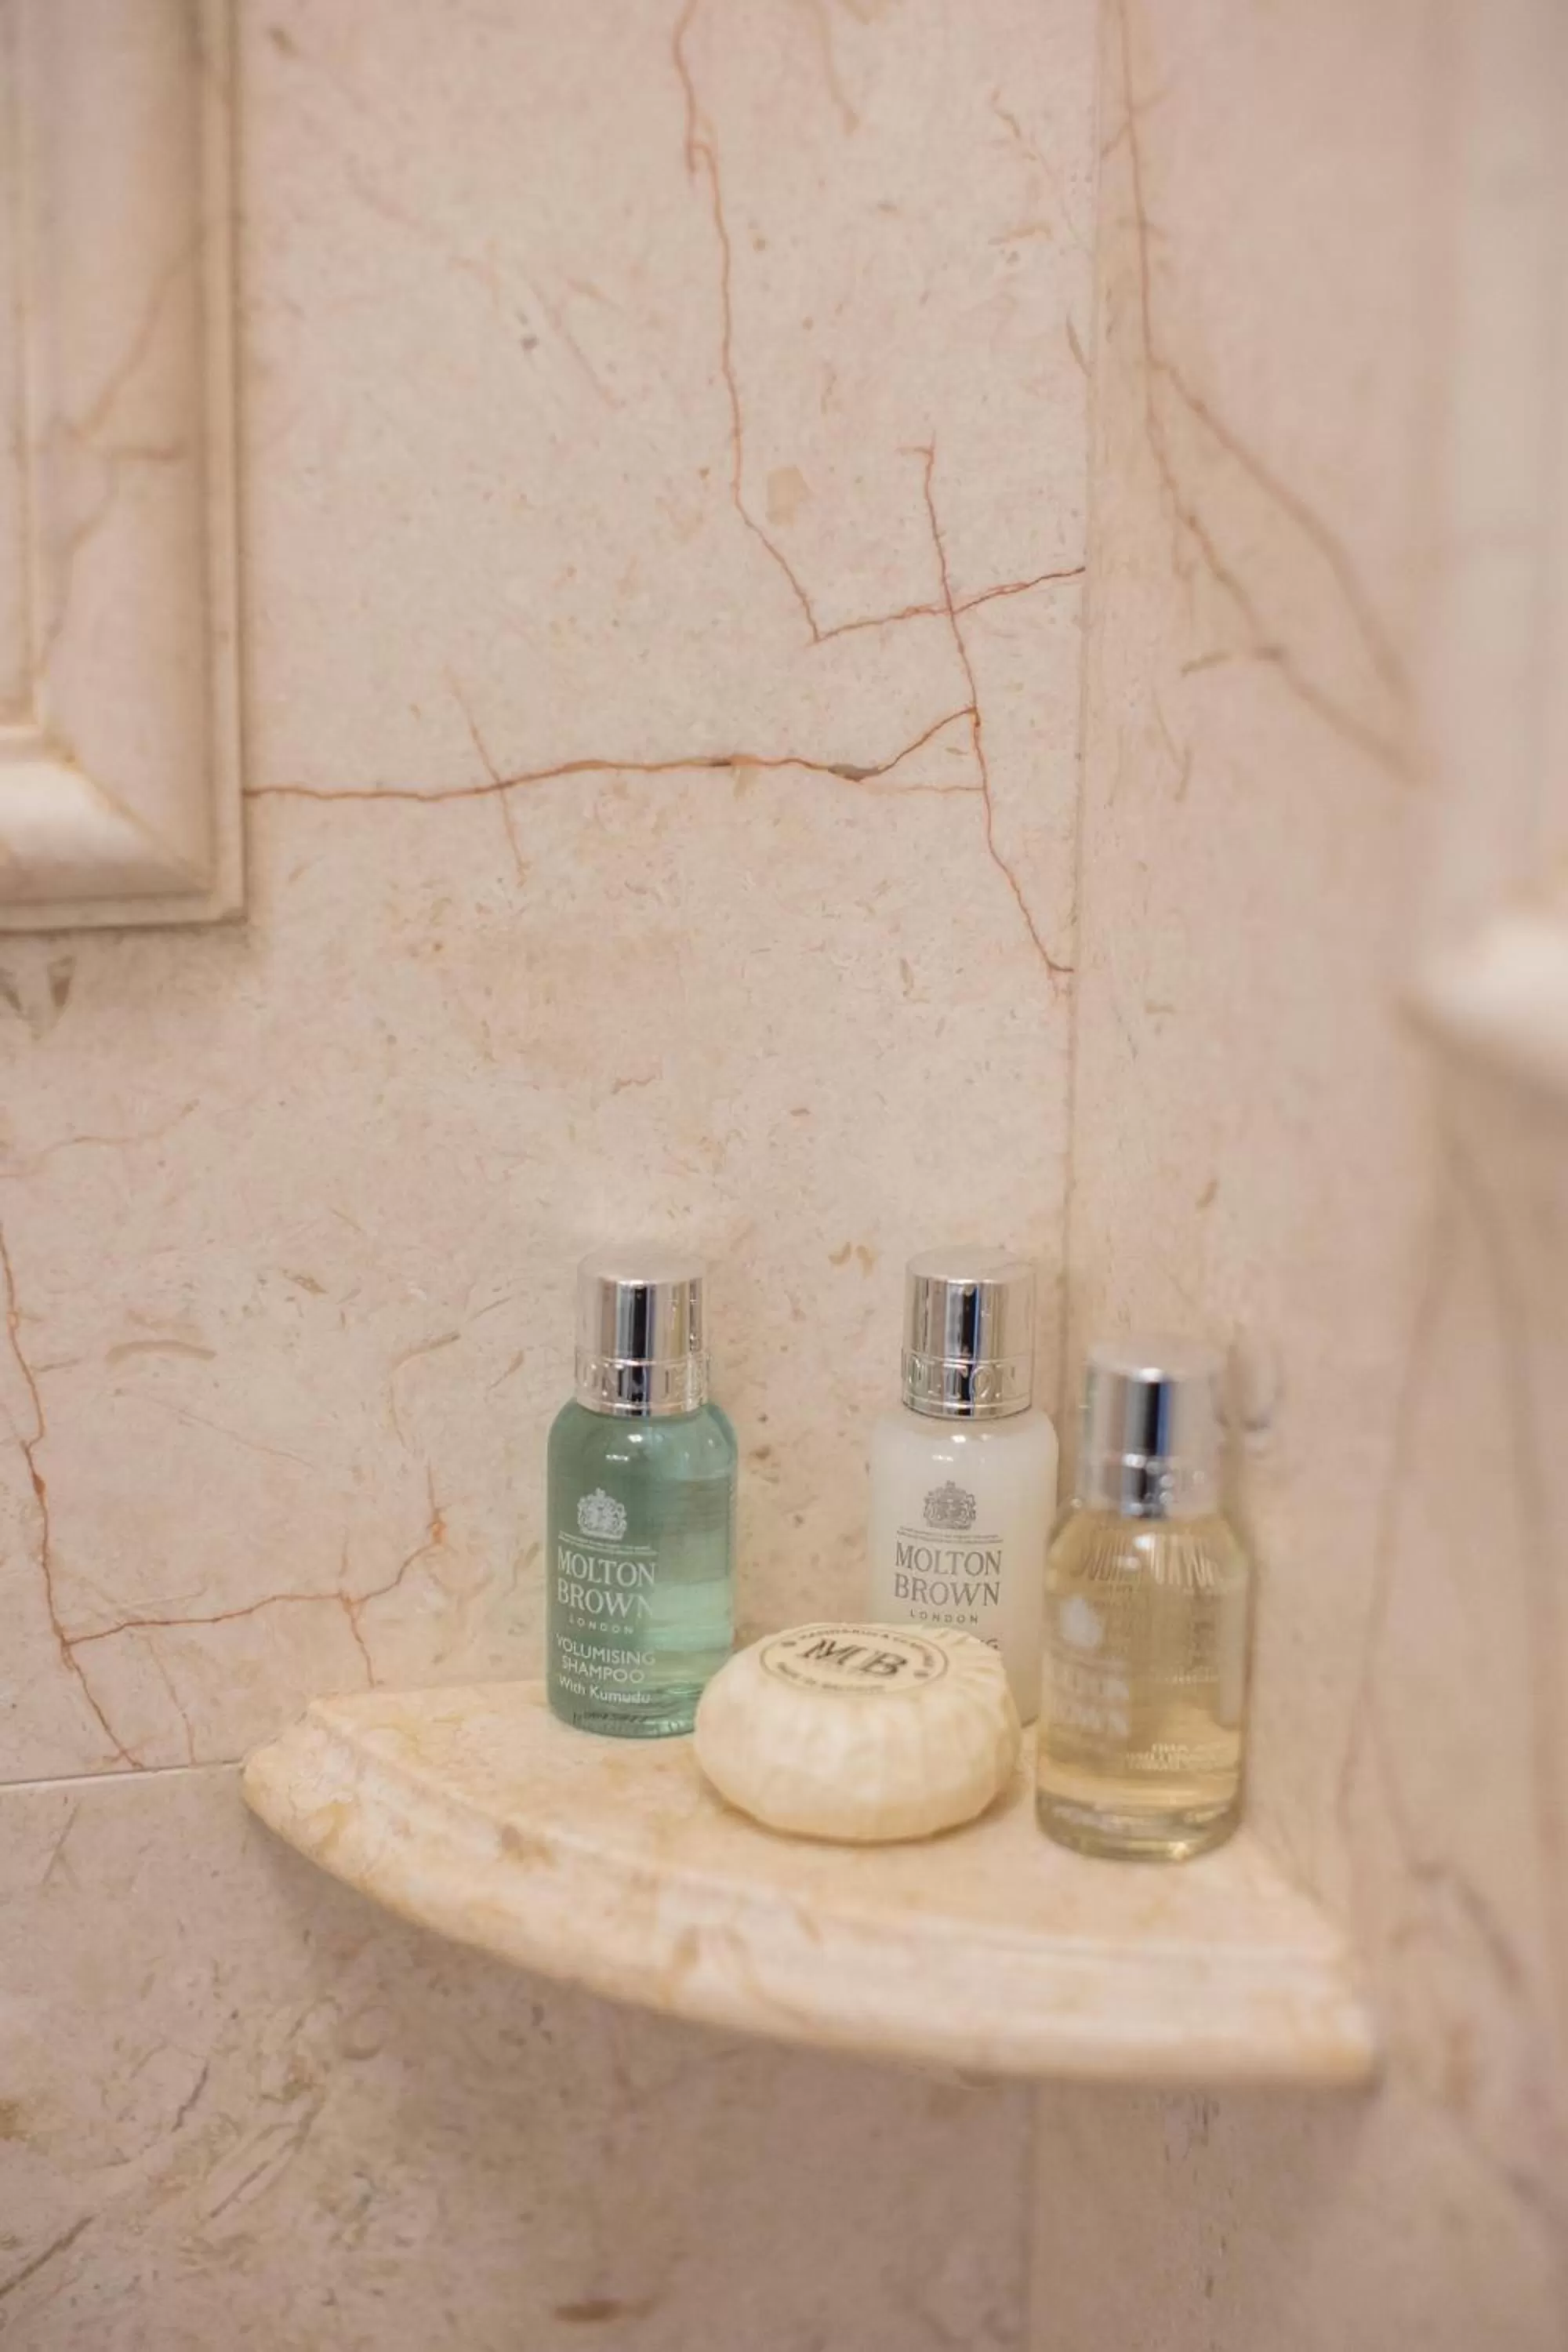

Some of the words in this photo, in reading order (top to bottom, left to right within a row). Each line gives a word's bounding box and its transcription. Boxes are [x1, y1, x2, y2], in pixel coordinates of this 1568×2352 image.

[557, 1546, 656, 1587] MOLTON
[895, 1542, 1003, 1576] MOLTON
[557, 1577, 653, 1618] BROWN
[894, 1573, 1000, 1606] BROWN
[568, 1613, 634, 1635] LONDON
[909, 1609, 978, 1624] LONDON
[556, 1633, 656, 1666] VOLUMISING
[798, 1638, 908, 1677] MB
[560, 1675, 586, 1696] With
[561, 1655, 645, 1683] SHAMPOO
